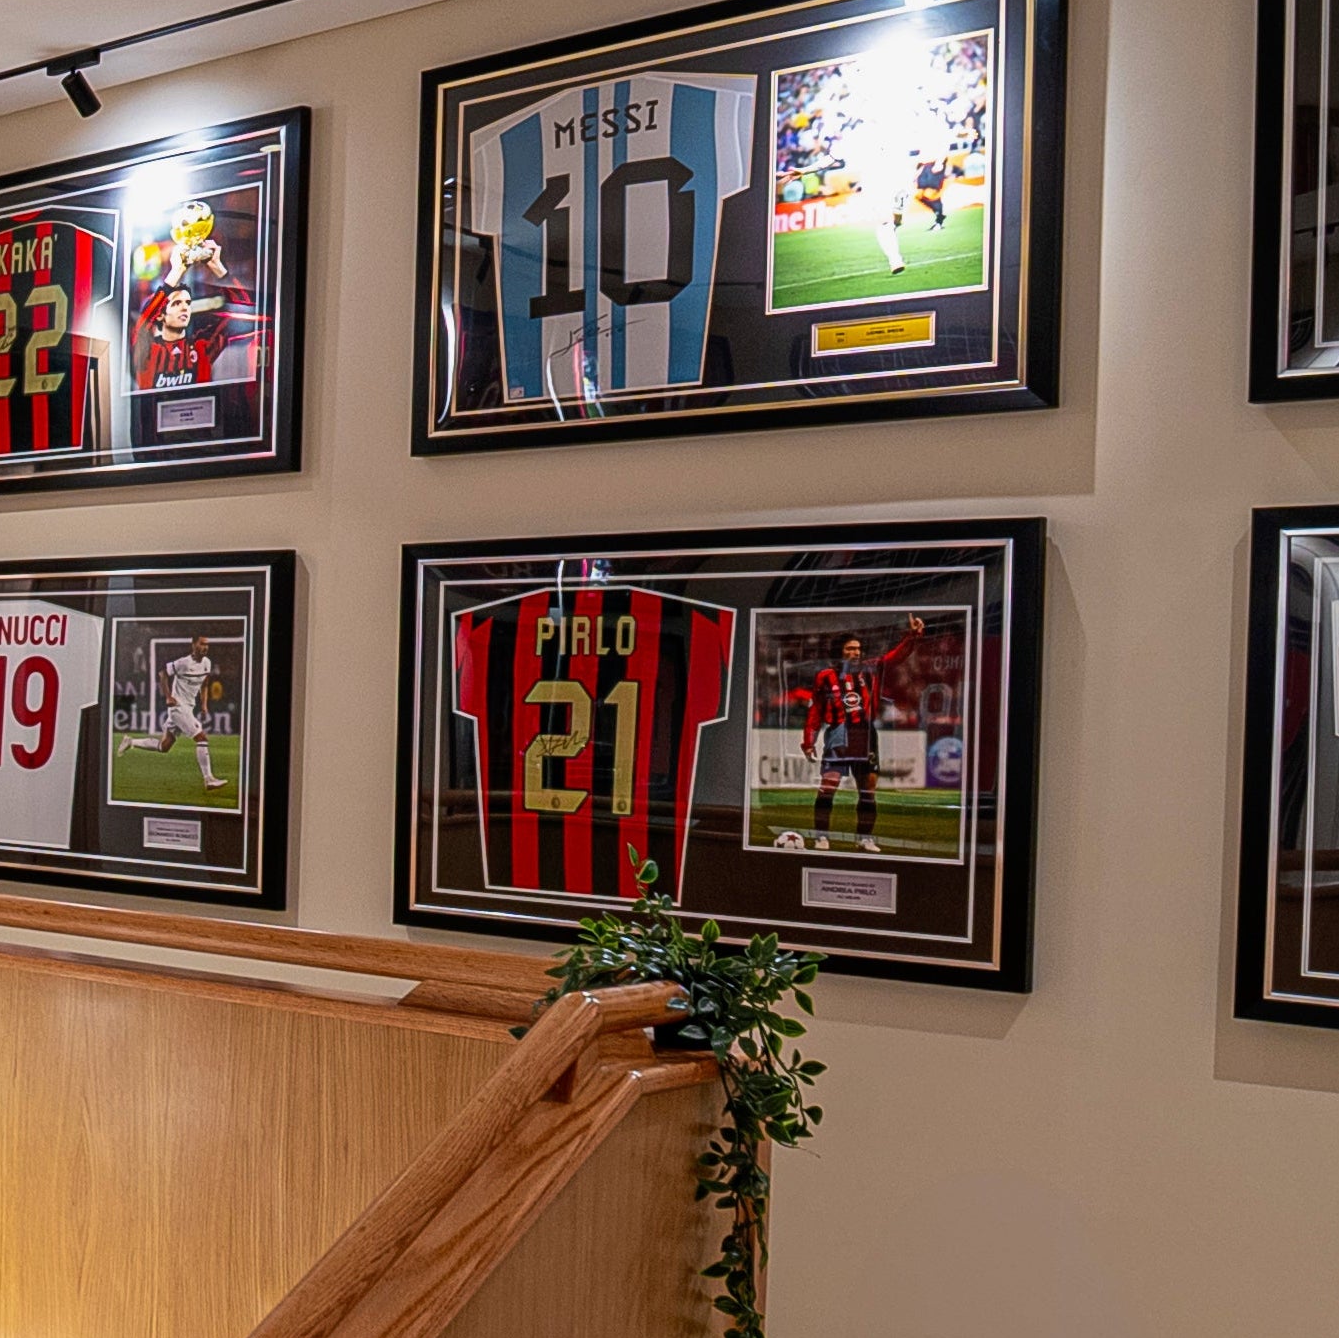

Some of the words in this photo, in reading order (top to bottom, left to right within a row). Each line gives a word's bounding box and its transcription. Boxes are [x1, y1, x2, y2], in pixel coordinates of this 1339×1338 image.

[553, 99, 659, 150] MESSI
[522, 156, 696, 320] 10
[155, 369, 193, 388] bwin
[535, 615, 637, 656] PIRLO
[524, 680, 639, 816] 21
